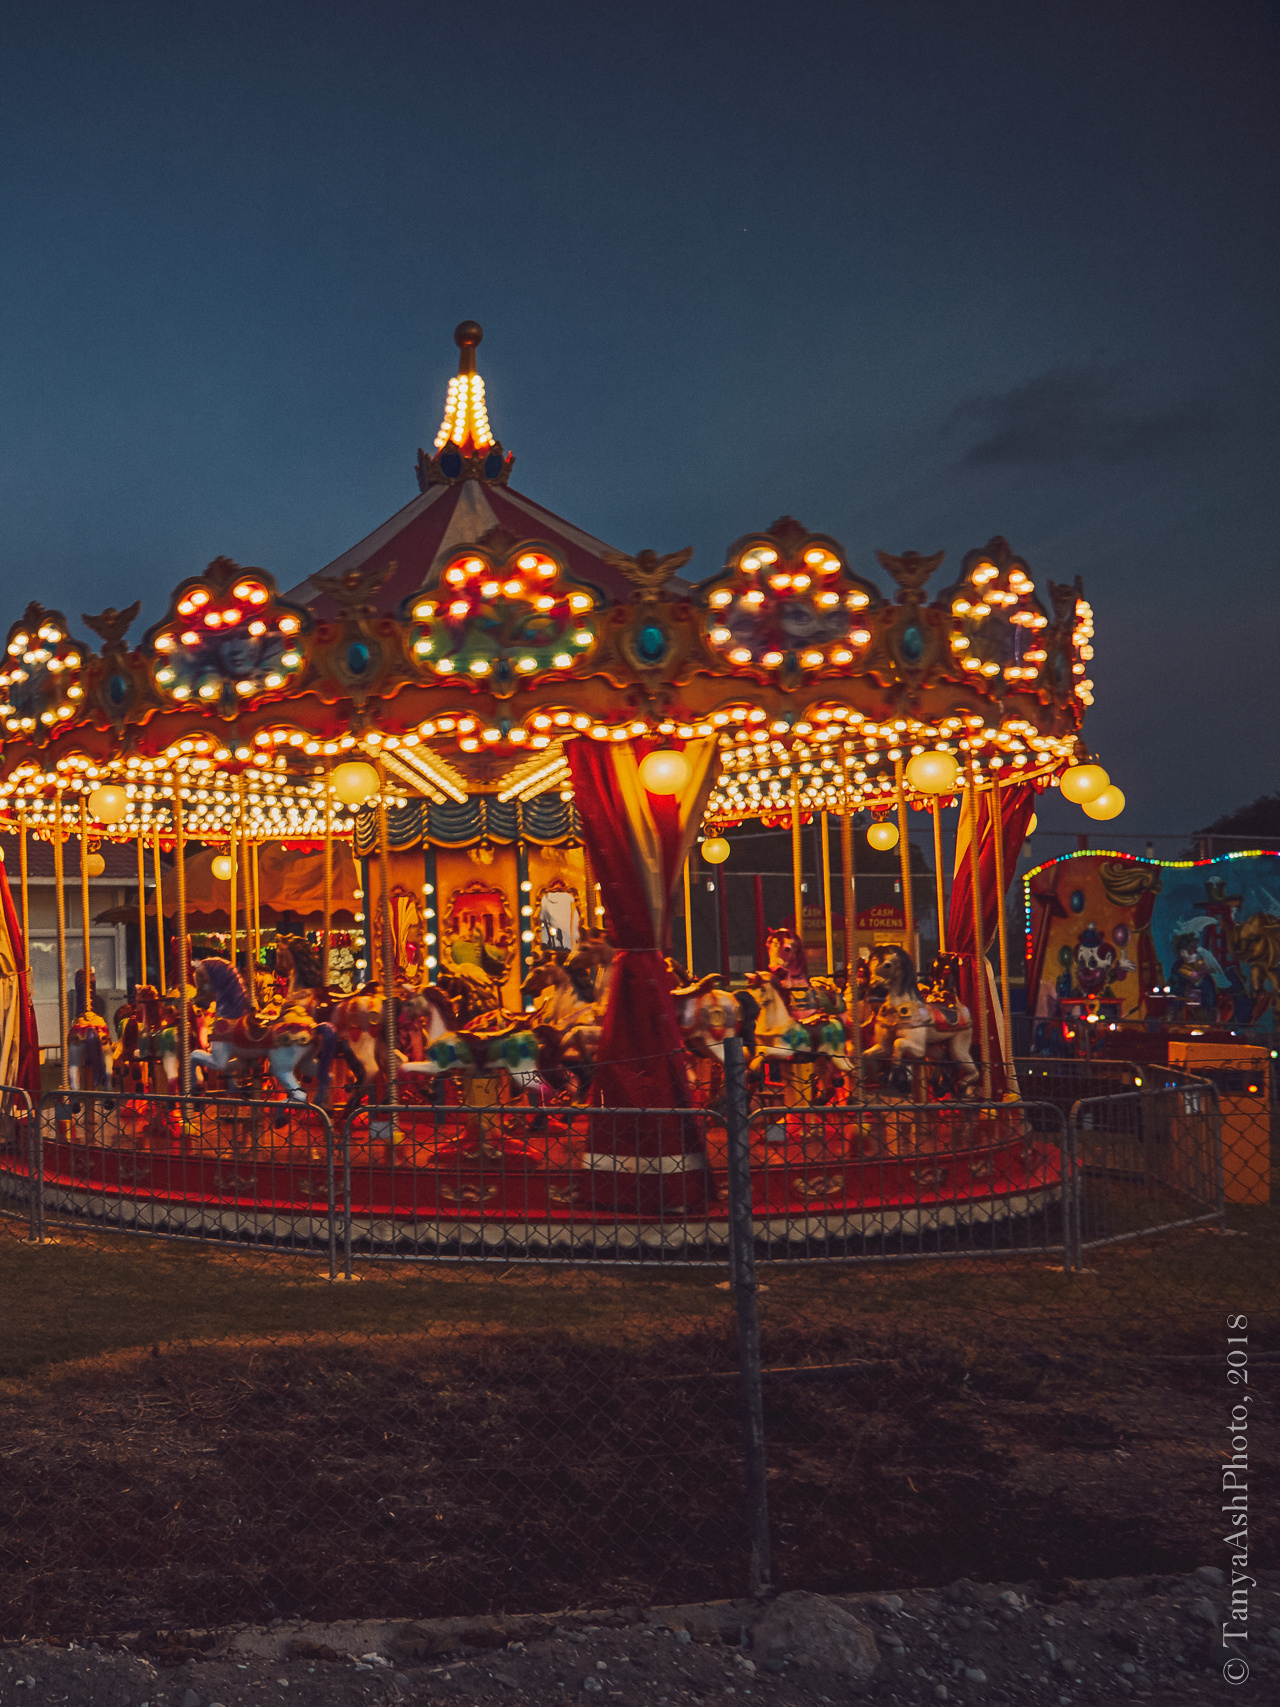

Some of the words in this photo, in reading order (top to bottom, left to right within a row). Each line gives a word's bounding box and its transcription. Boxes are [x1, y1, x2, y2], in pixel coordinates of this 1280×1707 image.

[871, 908, 894, 917] CASH
[859, 918, 866, 927] &
[869, 918, 903, 927] TOKENS
